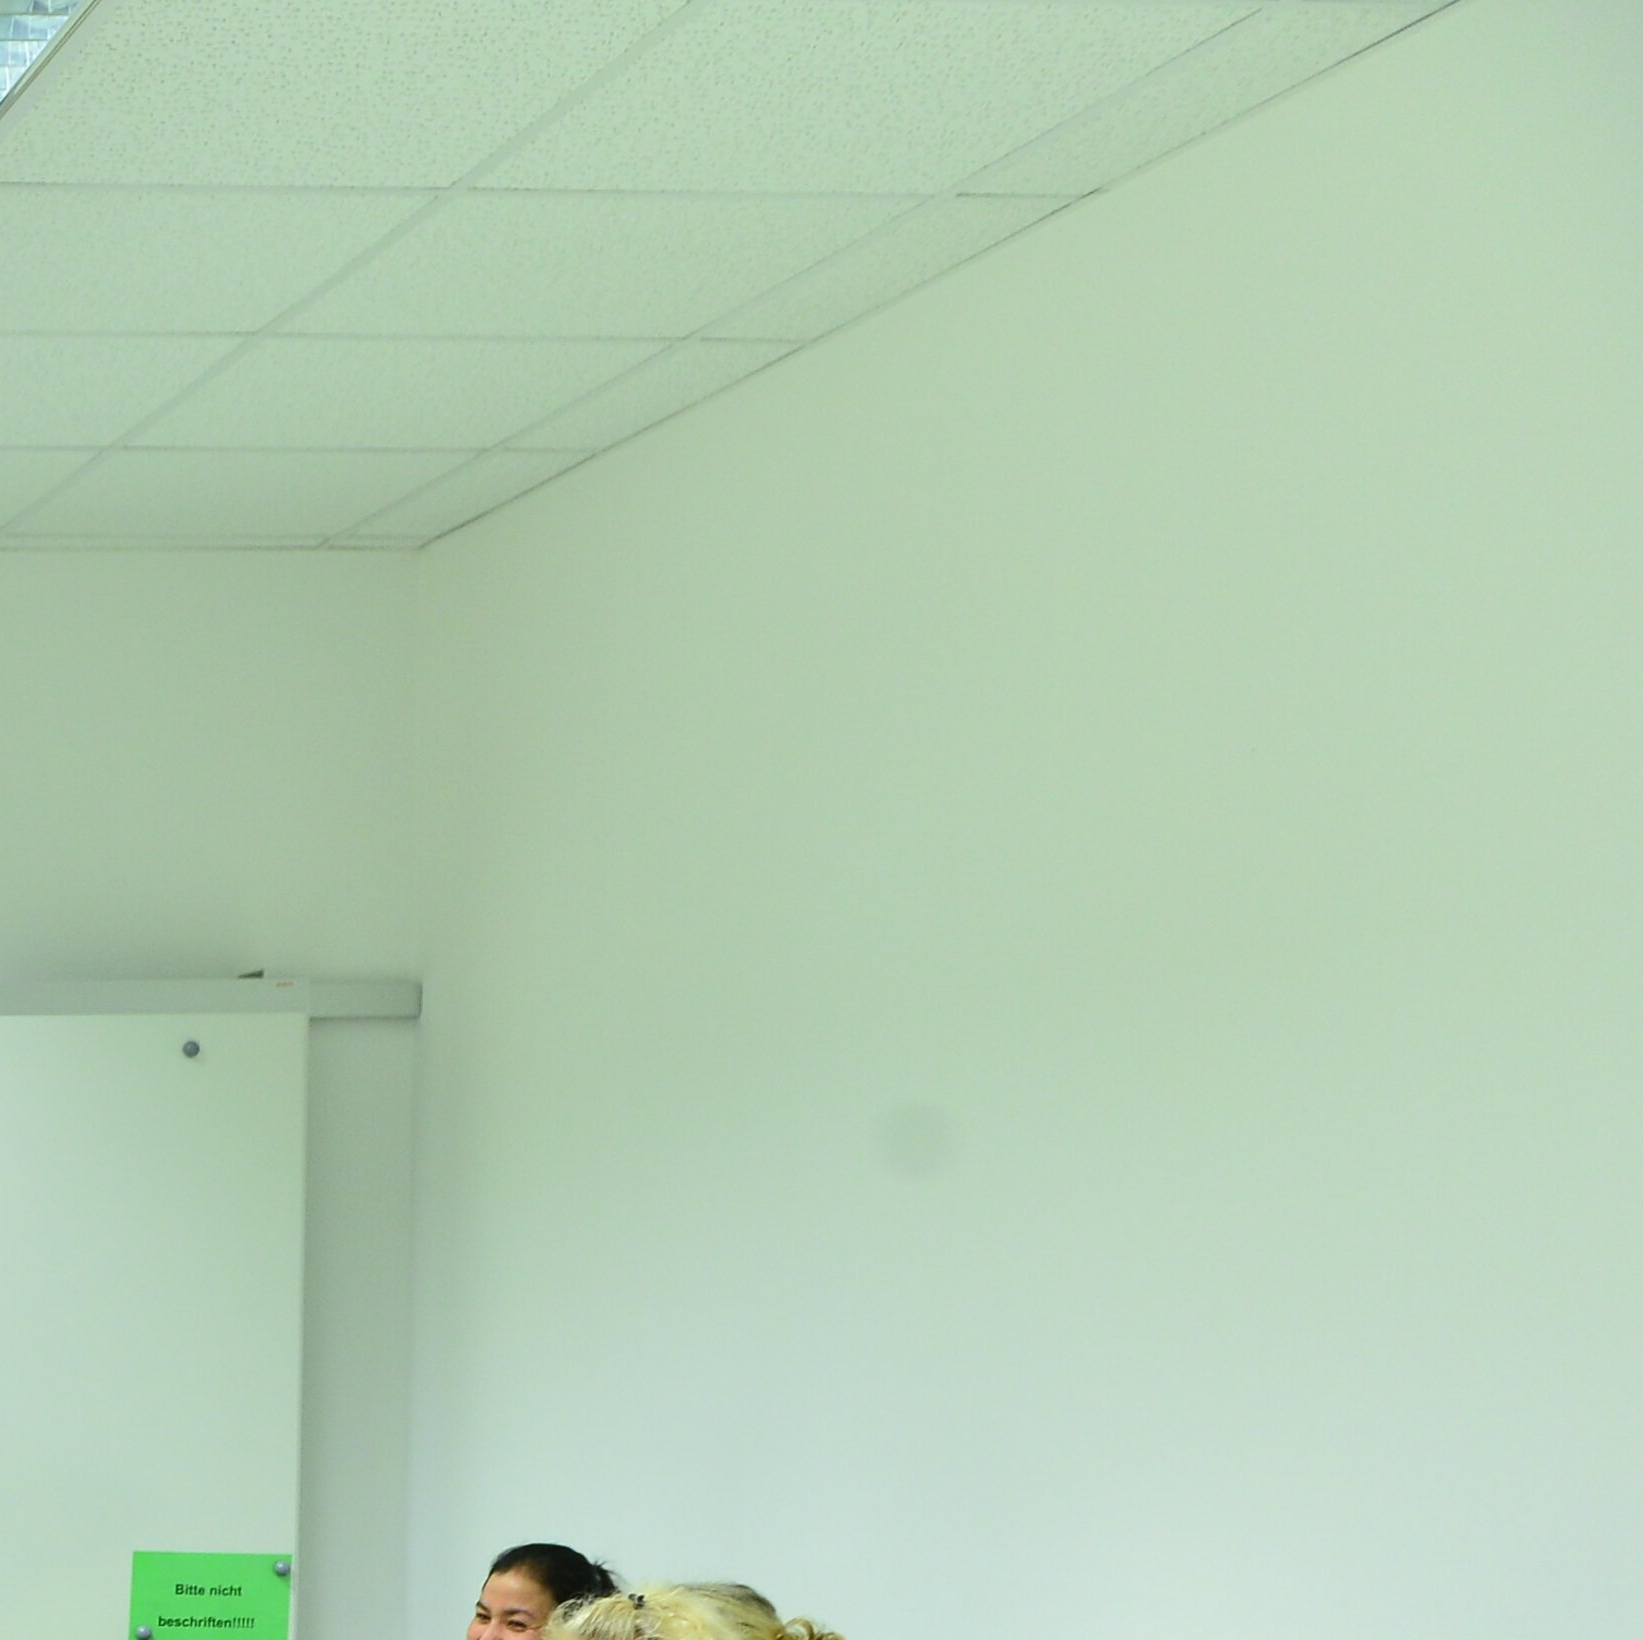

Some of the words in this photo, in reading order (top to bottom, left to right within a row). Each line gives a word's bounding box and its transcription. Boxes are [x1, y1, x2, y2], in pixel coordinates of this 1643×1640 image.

[175, 1584, 205, 1596] Bitte
[209, 1585, 242, 1597] nicht
[158, 1616, 255, 1629] beschriften!!!!!
